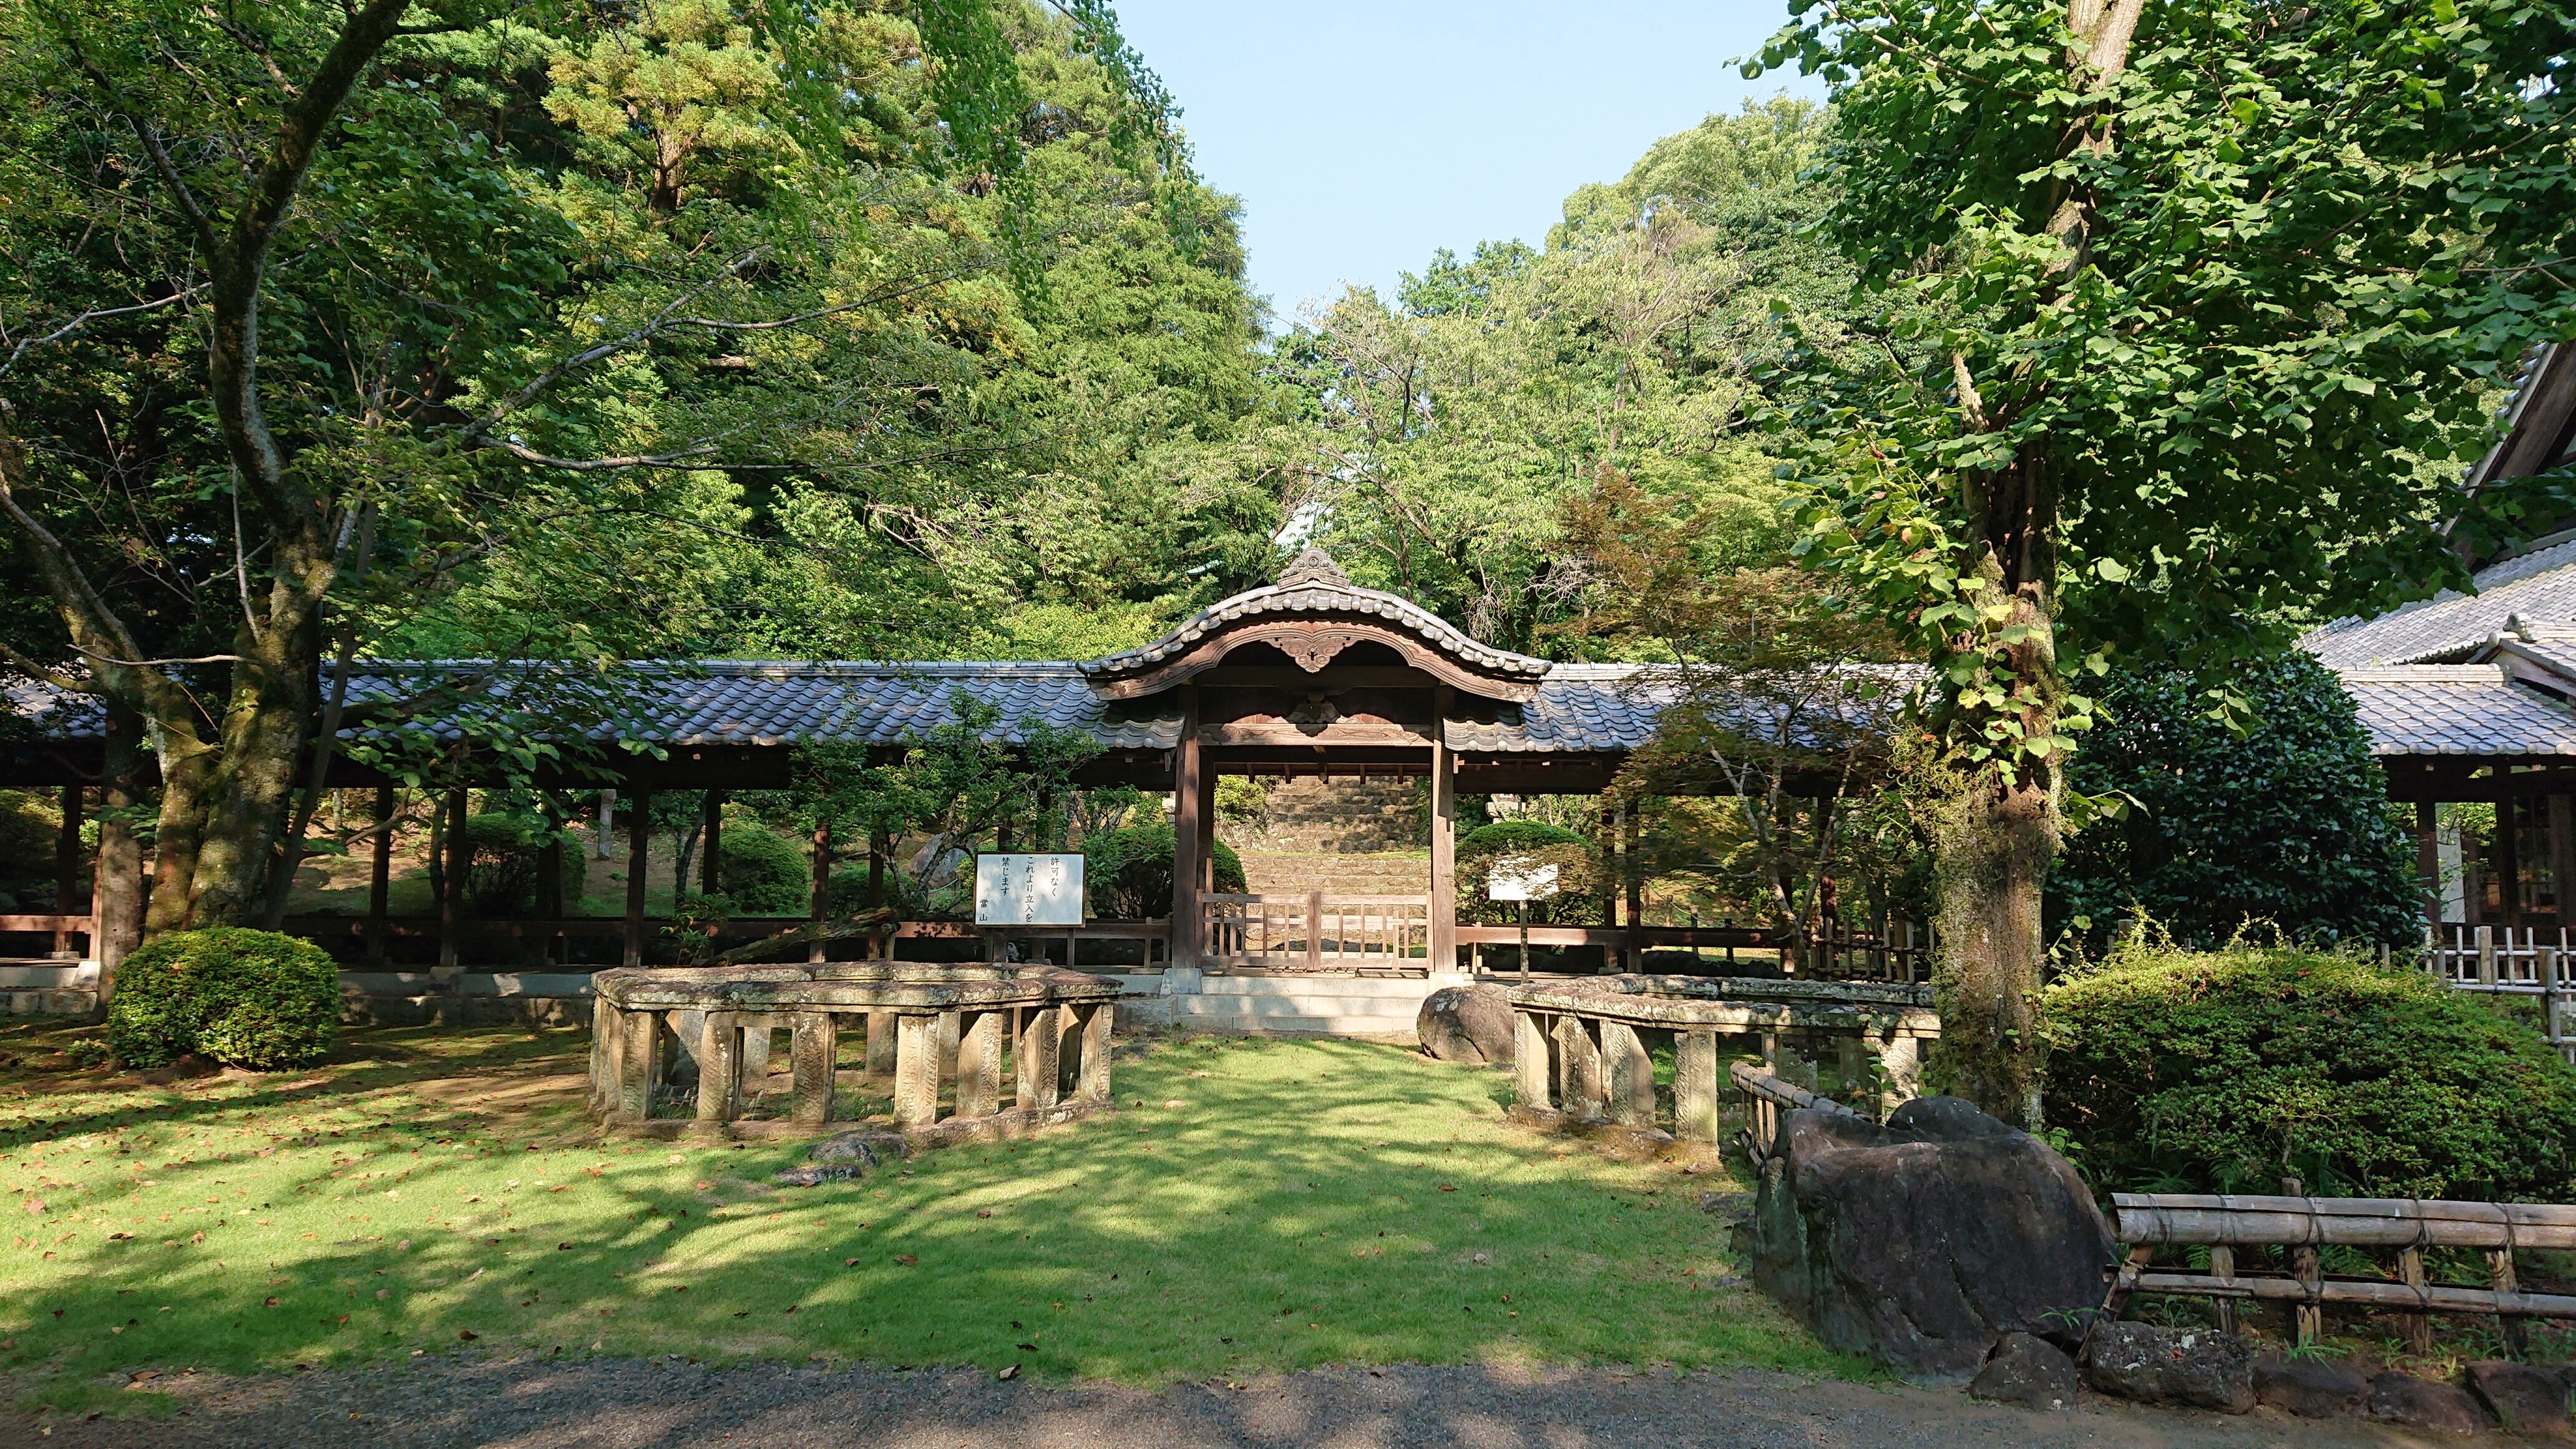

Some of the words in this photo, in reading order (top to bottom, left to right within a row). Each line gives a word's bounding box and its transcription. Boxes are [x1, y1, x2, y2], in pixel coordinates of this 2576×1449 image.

[1000, 857, 1010, 896] 禁じます
[1025, 857, 1035, 922] これより立入を
[1050, 857, 1060, 897] 許可なく
[979, 899, 988, 921] 當山
